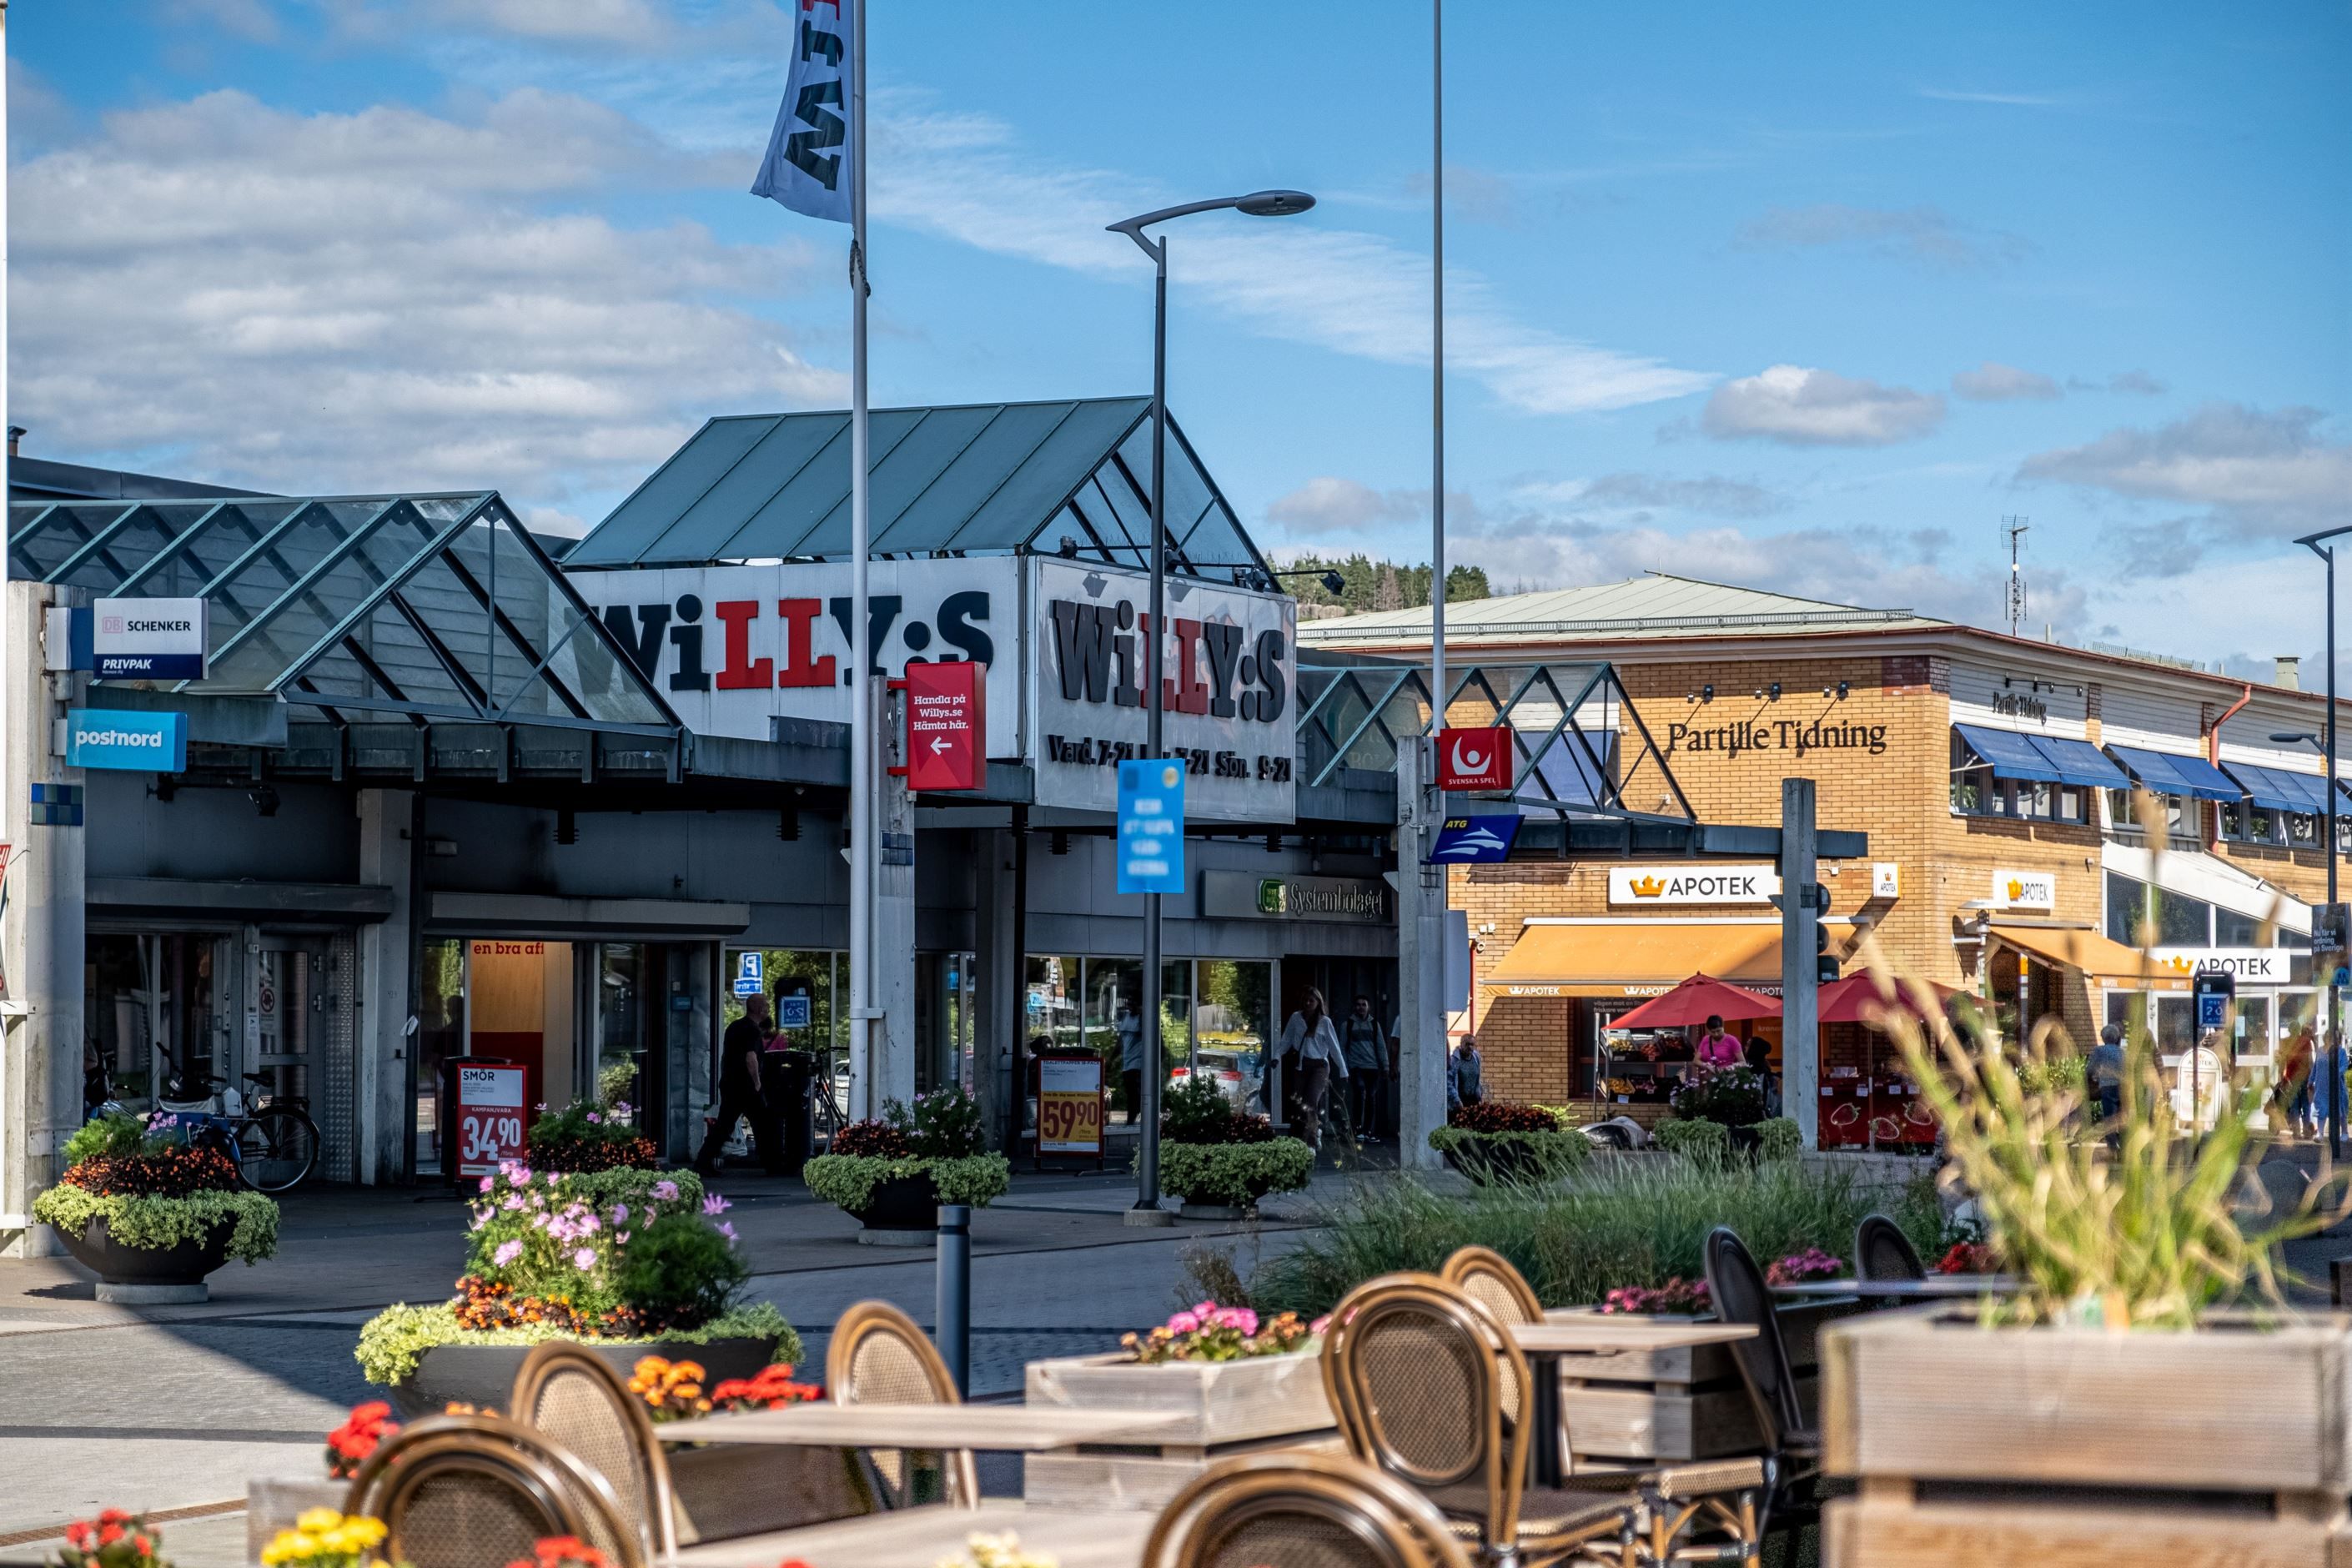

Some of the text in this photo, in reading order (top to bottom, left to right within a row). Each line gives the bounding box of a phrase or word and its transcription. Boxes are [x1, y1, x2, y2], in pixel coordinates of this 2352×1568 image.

[104, 619, 191, 631] DB SCHENKER
[103, 659, 152, 670] PRIVPAK
[914, 693, 966, 706] Handla på
[919, 708, 963, 719] Willys.se
[913, 720, 969, 731] Hämta här.
[75, 730, 163, 748] postnord
[1668, 720, 1887, 755] Partille Tidning
[1048, 735, 1096, 765] Vard.
[1214, 751, 1251, 778] Sön.
[1258, 755, 1292, 782] 9-21
[1445, 820, 1468, 829] ATG
[1668, 877, 1756, 897] APOTEK
[1880, 883, 1896, 892] APOTEK
[2020, 882, 2048, 901] APOTEK
[1291, 883, 1383, 918] Systembolaget
[2314, 937, 2334, 946] ordning
[2321, 943, 2344, 952] Sverige
[474, 944, 491, 954] en
[495, 942, 520, 954] bra
[2197, 957, 2271, 975] APOTEK
[1524, 988, 1560, 996] APOTEK
[1639, 987, 1673, 996] APOTE
[1756, 987, 1783, 996] APOTE
[463, 1068, 495, 1082] SMÖR
